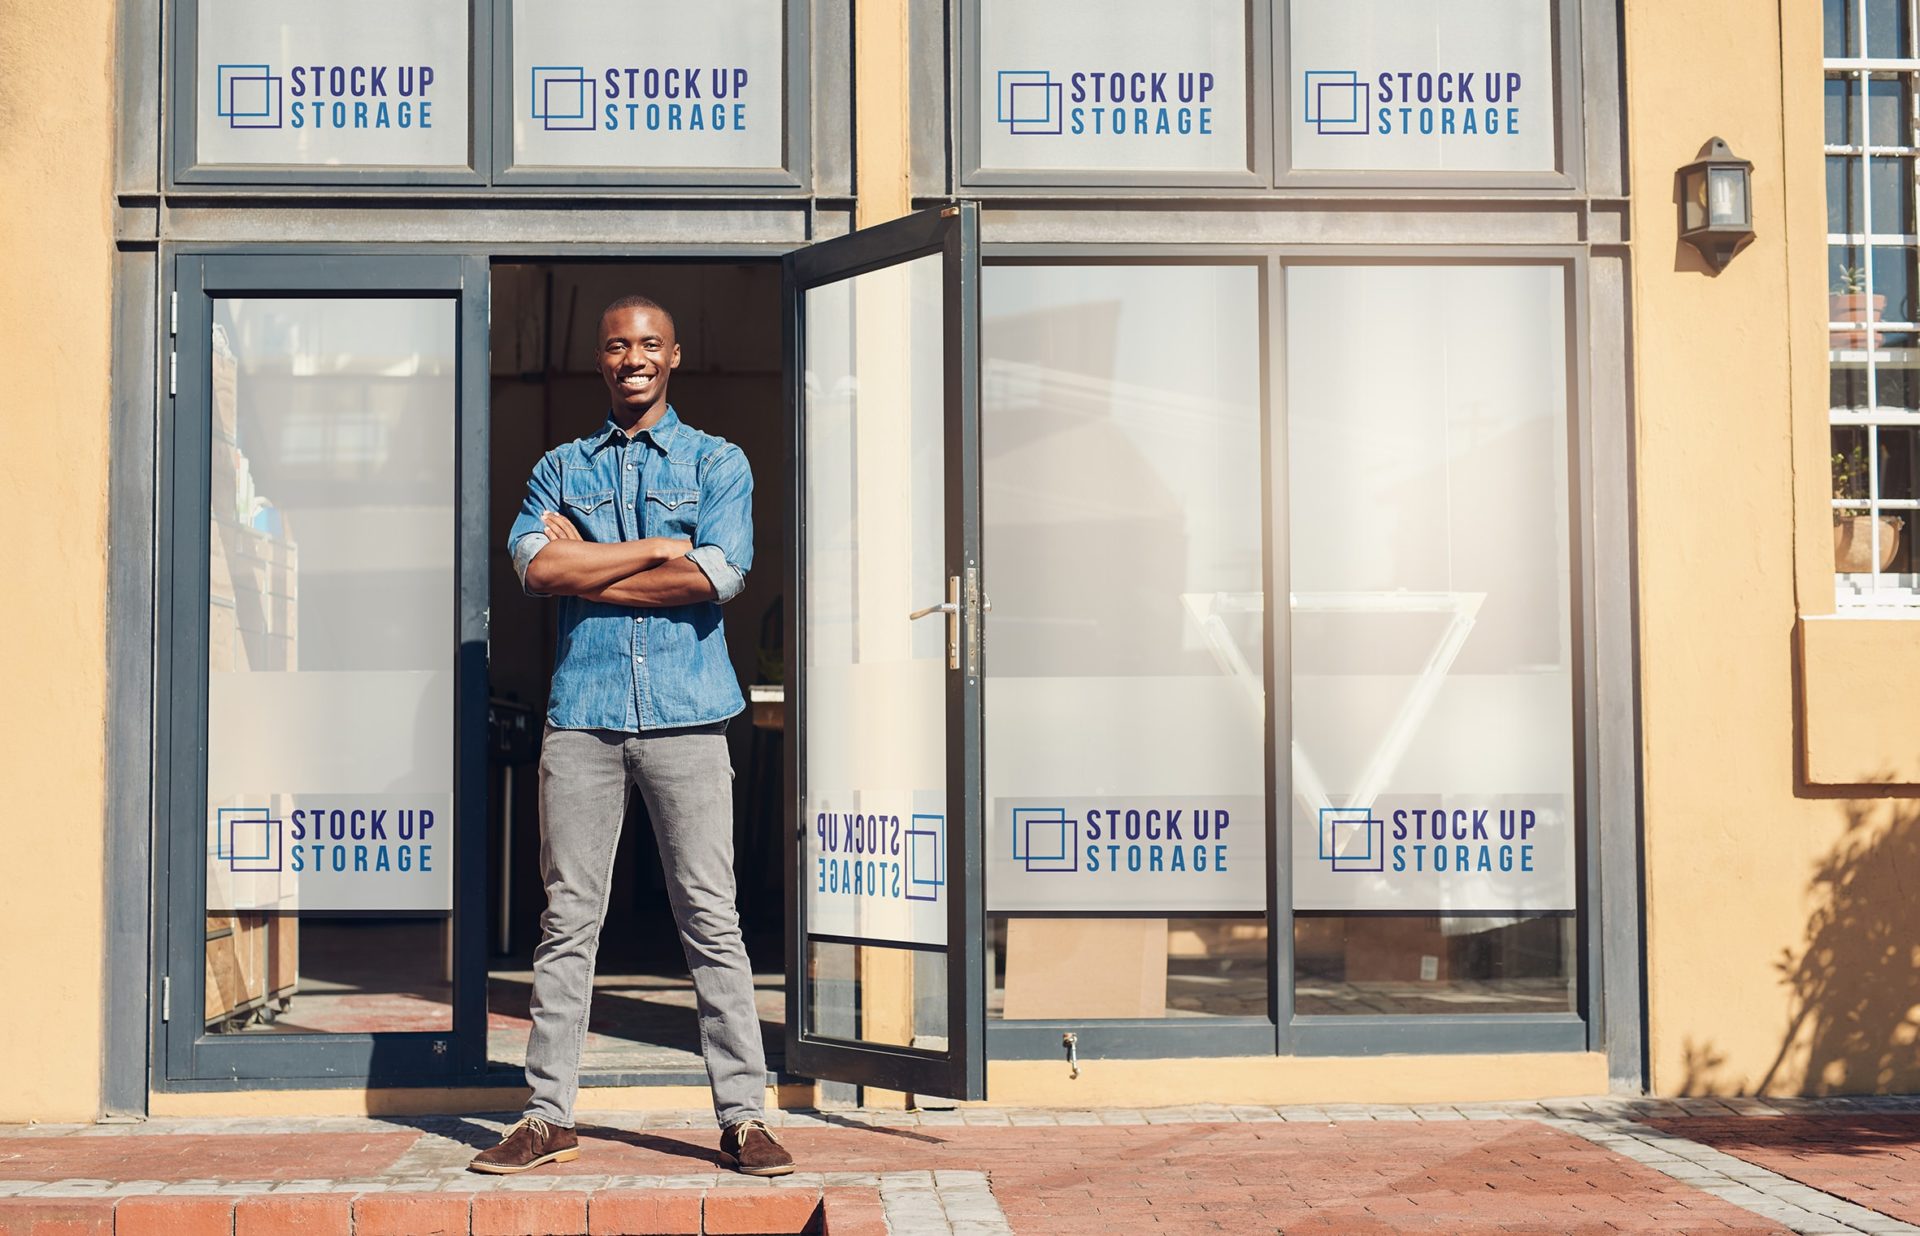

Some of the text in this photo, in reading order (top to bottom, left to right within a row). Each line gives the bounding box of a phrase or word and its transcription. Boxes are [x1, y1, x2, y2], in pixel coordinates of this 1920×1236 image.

[291, 66, 434, 98] STOCK UP
[605, 68, 748, 100] STOCK UP
[1071, 72, 1214, 103] STOCK UP
[1378, 72, 1521, 103] STOCK UP
[290, 101, 433, 129] STORAGE
[604, 103, 747, 131] STORAGE
[1070, 107, 1213, 135] STORAGE
[1377, 107, 1521, 135] STORAGE
[291, 808, 434, 840] STOCK UP
[1086, 809, 1229, 840] STOCK UP
[1392, 809, 1536, 840] STOCK UP
[291, 843, 433, 873] STORAGE
[1086, 844, 1228, 872] STORAGE
[1392, 843, 1535, 872] STORAGE
